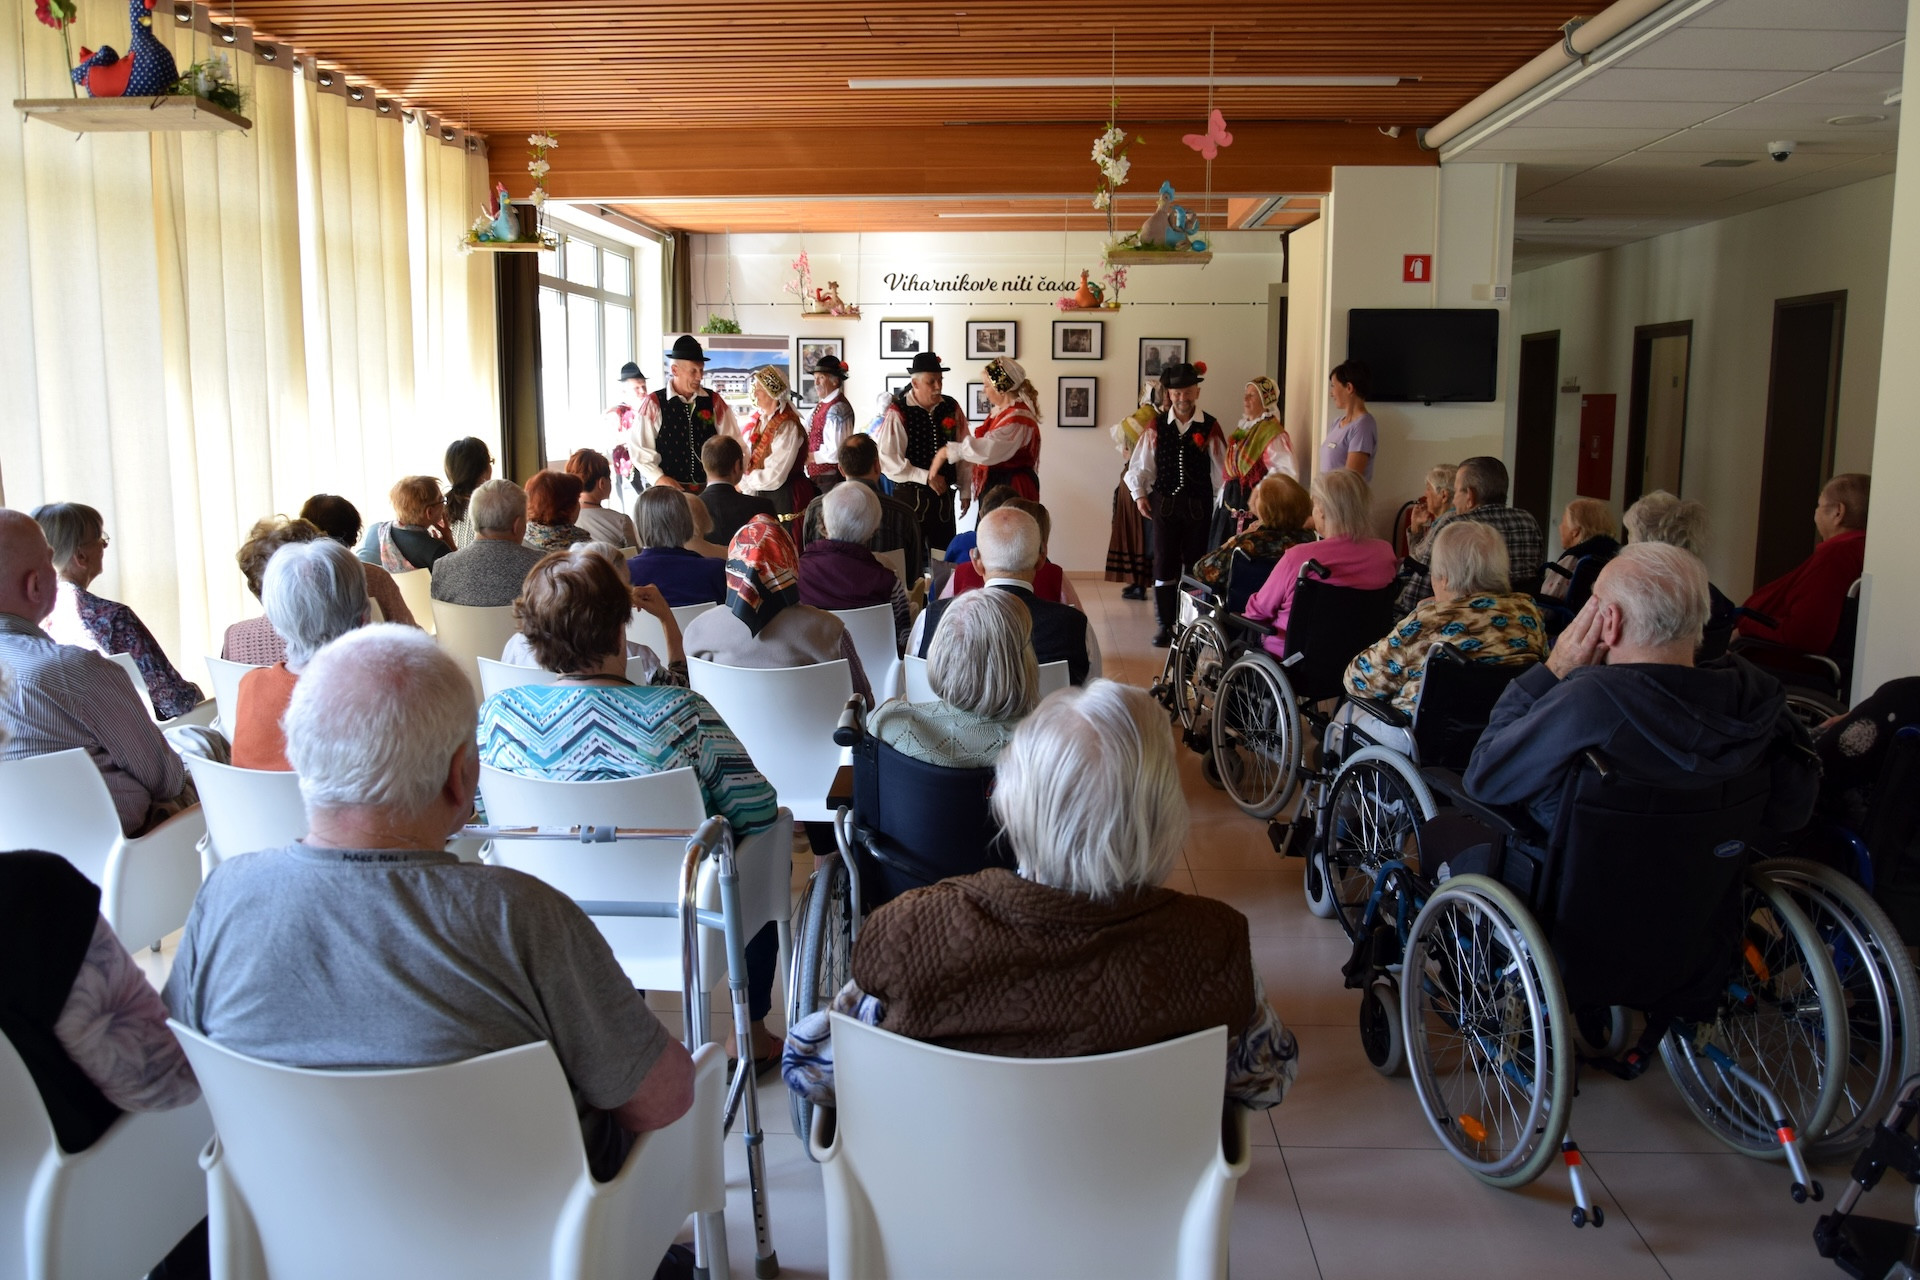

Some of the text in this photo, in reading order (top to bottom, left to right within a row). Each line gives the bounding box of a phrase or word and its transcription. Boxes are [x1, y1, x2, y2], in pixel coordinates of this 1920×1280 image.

[883, 272, 1080, 292] Viharnikove niti časa
